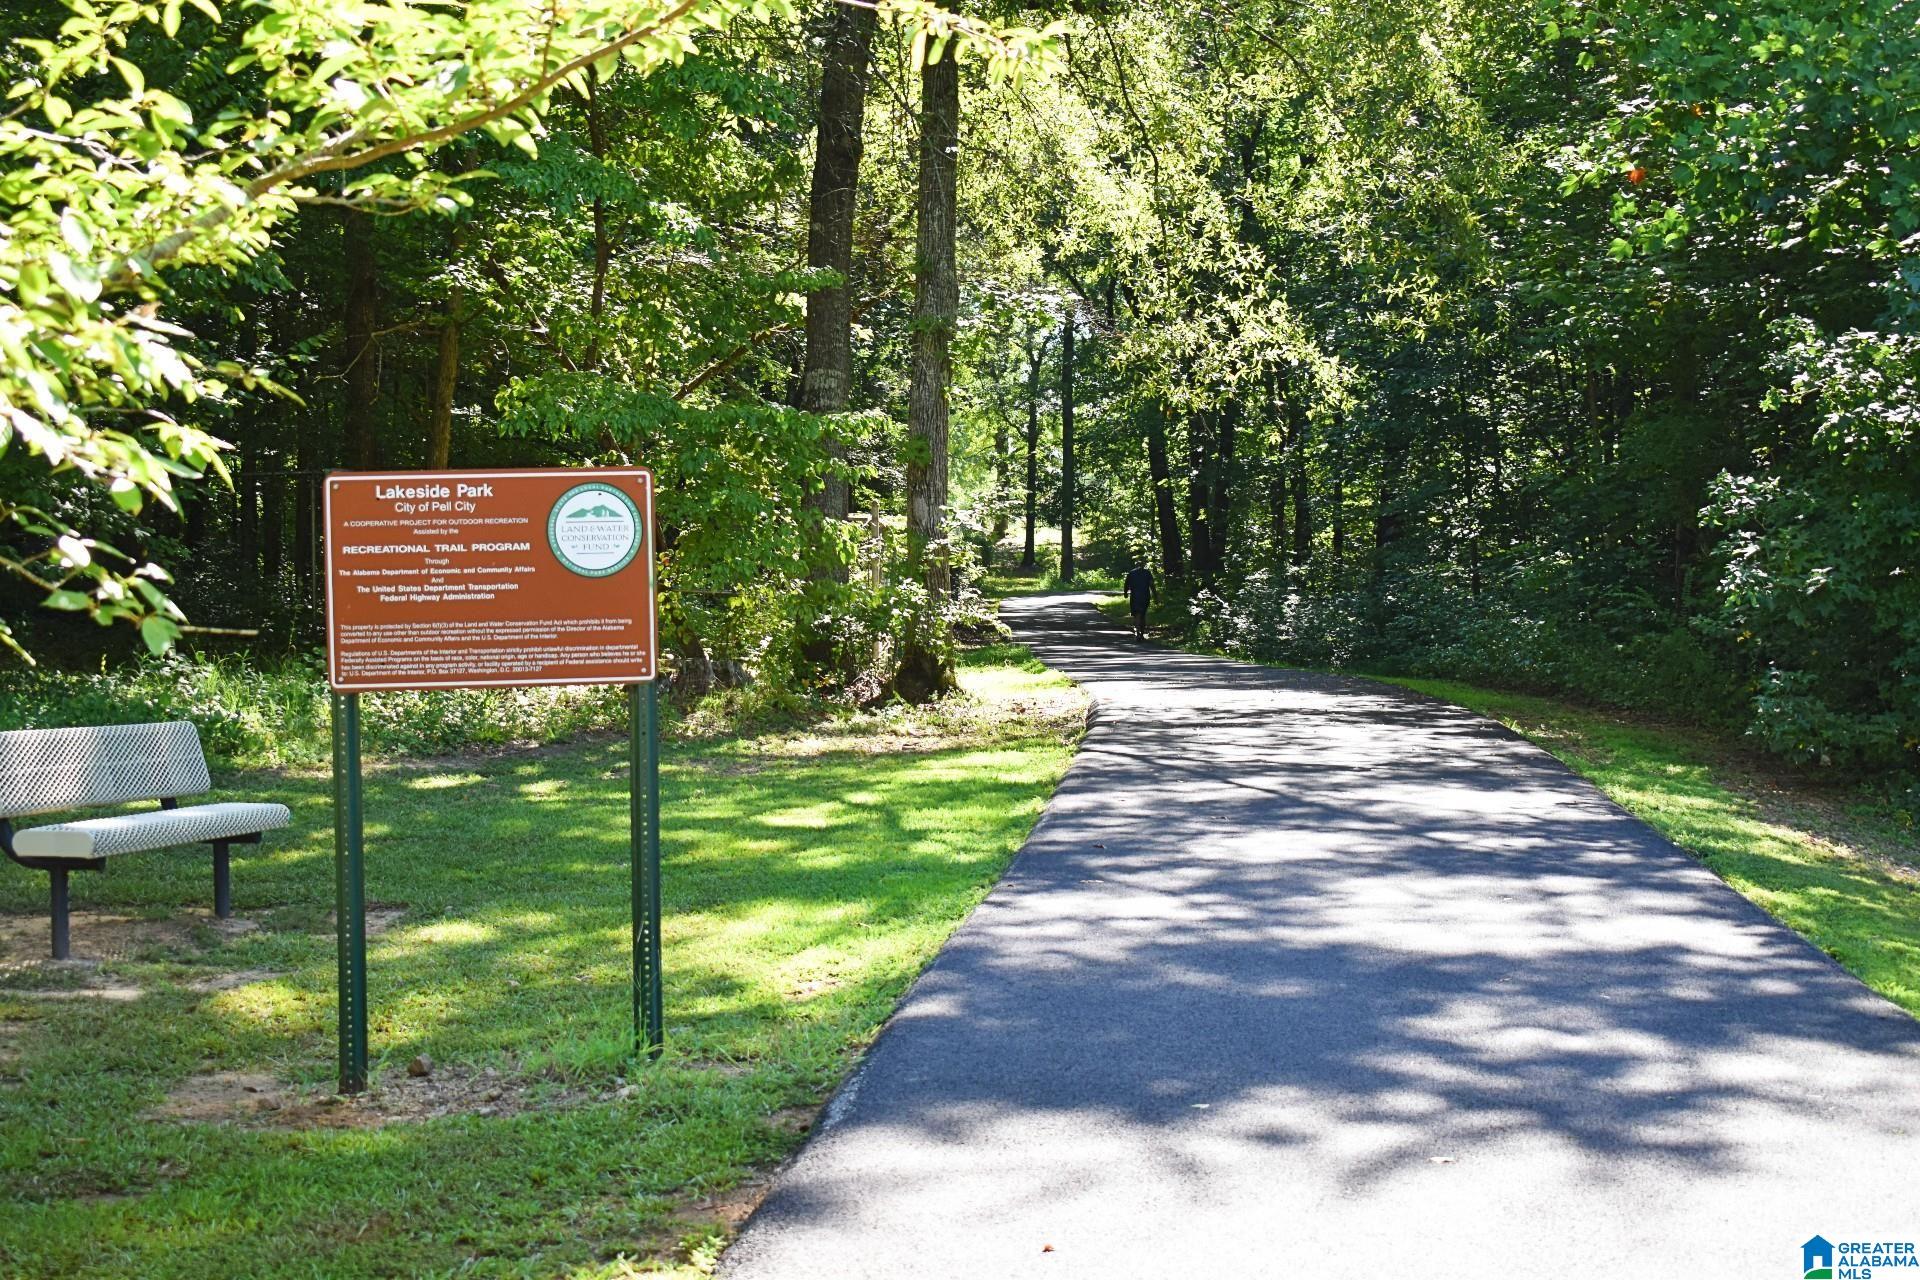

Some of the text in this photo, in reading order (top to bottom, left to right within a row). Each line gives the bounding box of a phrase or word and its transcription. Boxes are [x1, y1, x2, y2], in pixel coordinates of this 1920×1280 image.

[376, 483, 493, 499] Lakeside Park
[395, 501, 476, 514] City of Pell City
[561, 534, 628, 542] CONSERVATION
[342, 542, 530, 554] RECREATIONAL TRAIL PROGRAM
[425, 557, 449, 566] Through
[382, 568, 419, 577] Department
[477, 566, 512, 574] Community
[372, 585, 395, 593] United
[424, 584, 465, 593] Department
[468, 582, 519, 591] Transportation
[410, 594, 440, 602] Highway
[443, 592, 495, 600] Administration
